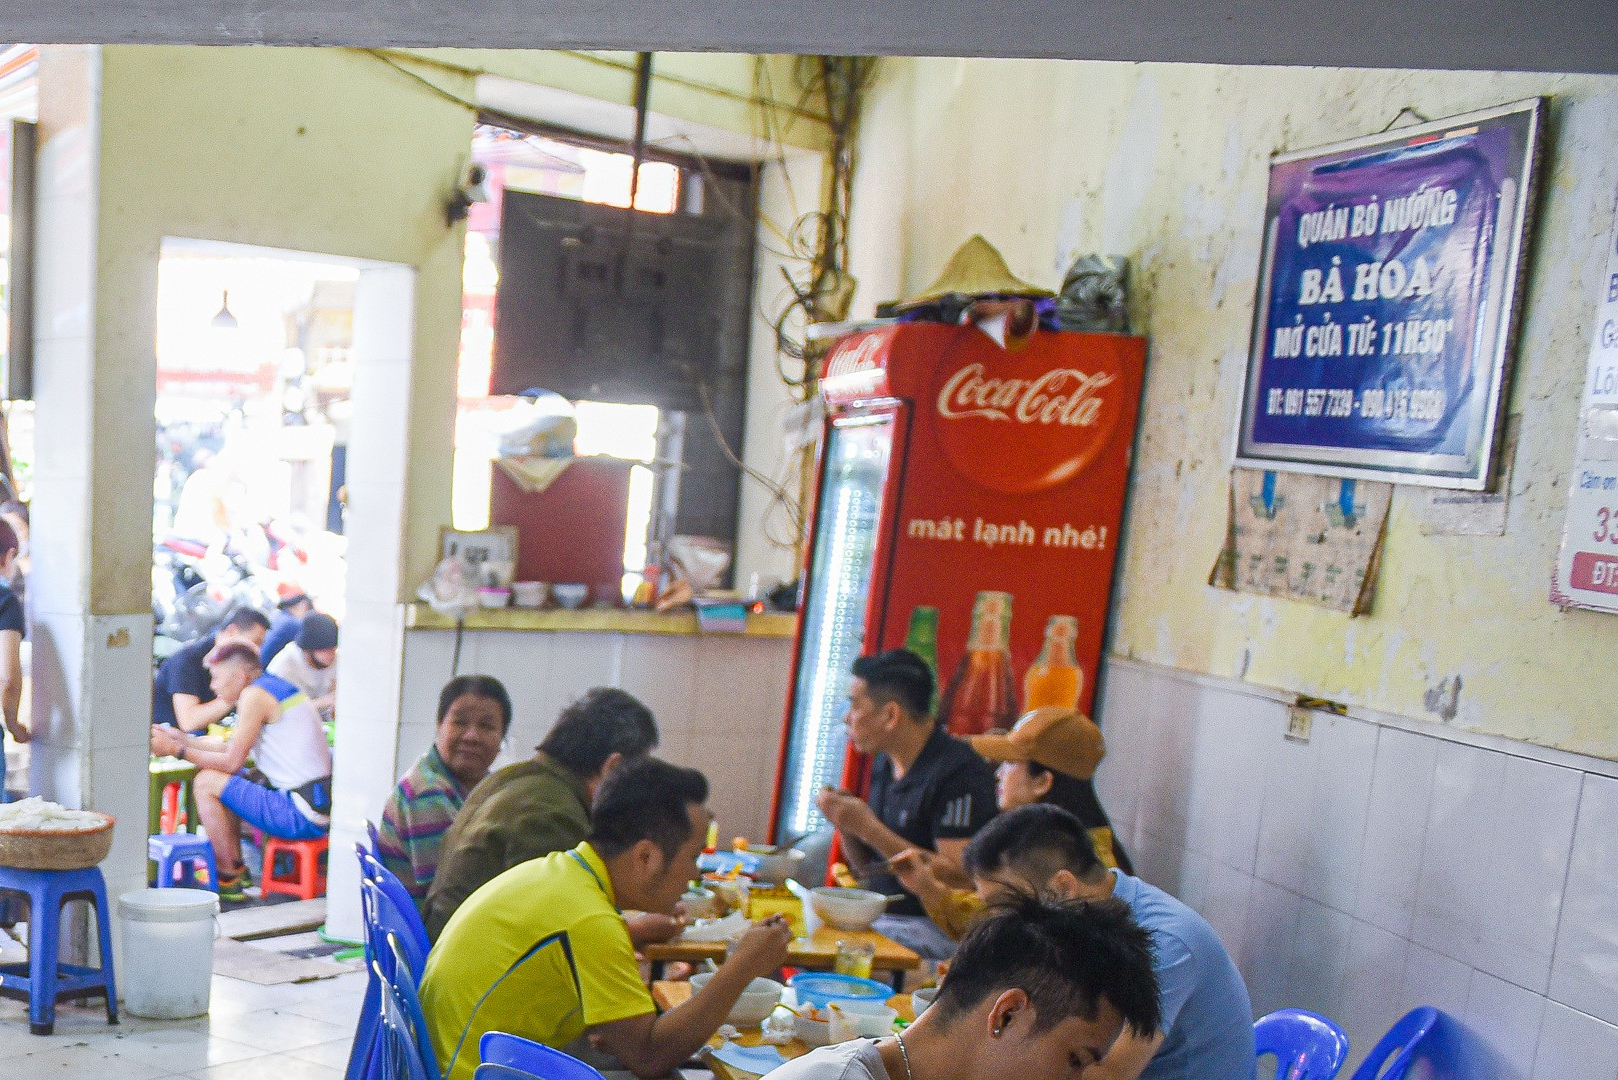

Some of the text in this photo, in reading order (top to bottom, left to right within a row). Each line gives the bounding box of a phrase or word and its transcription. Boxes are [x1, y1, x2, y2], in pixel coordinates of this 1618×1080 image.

[1298, 203, 1349, 248] QUÁN
[1350, 194, 1380, 238] BÒ
[1299, 255, 1433, 305] BÀ HOA
[1273, 313, 1305, 358] MỞ
[1305, 311, 1342, 357] CỬA
[908, 515, 1107, 549] mát lạnh nhé!
